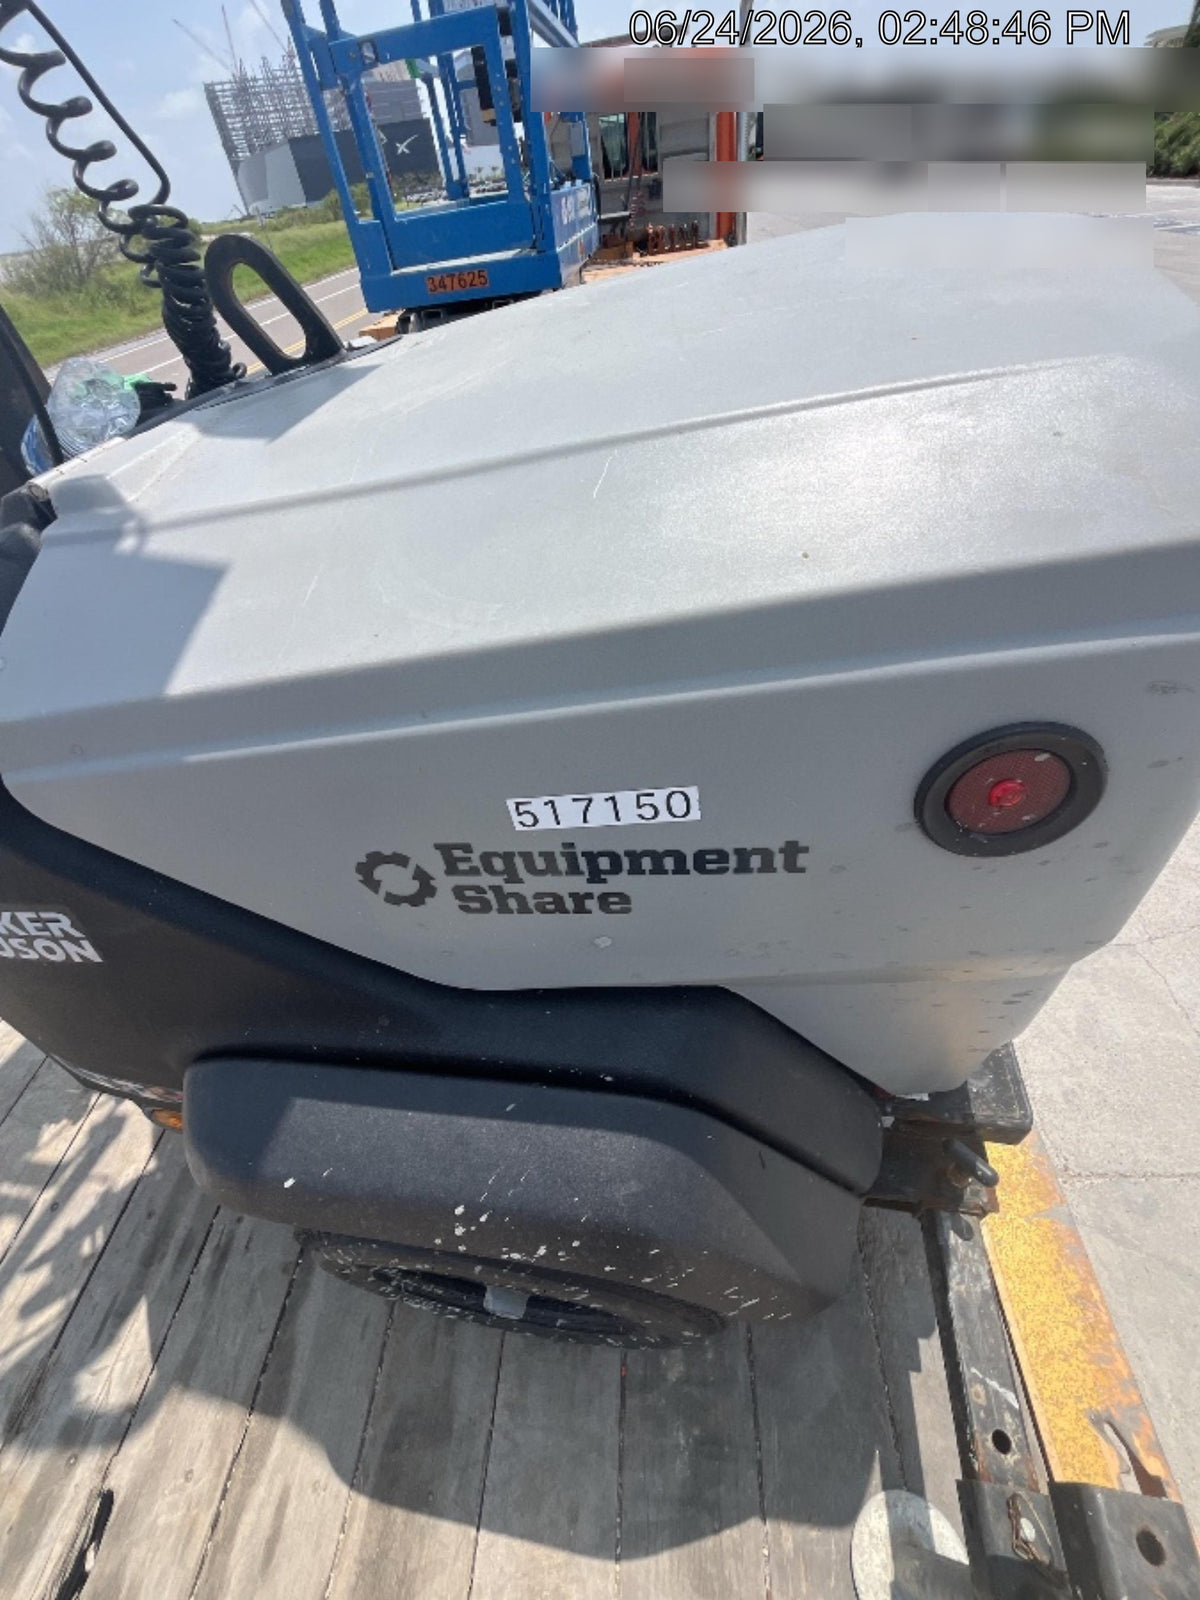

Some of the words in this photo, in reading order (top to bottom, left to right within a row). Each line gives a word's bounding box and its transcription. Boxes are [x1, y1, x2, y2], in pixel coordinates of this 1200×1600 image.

[427, 269, 488, 292] 347625
[514, 790, 691, 828] 517150
[434, 841, 809, 884] Equipment
[451, 885, 632, 914] Share
